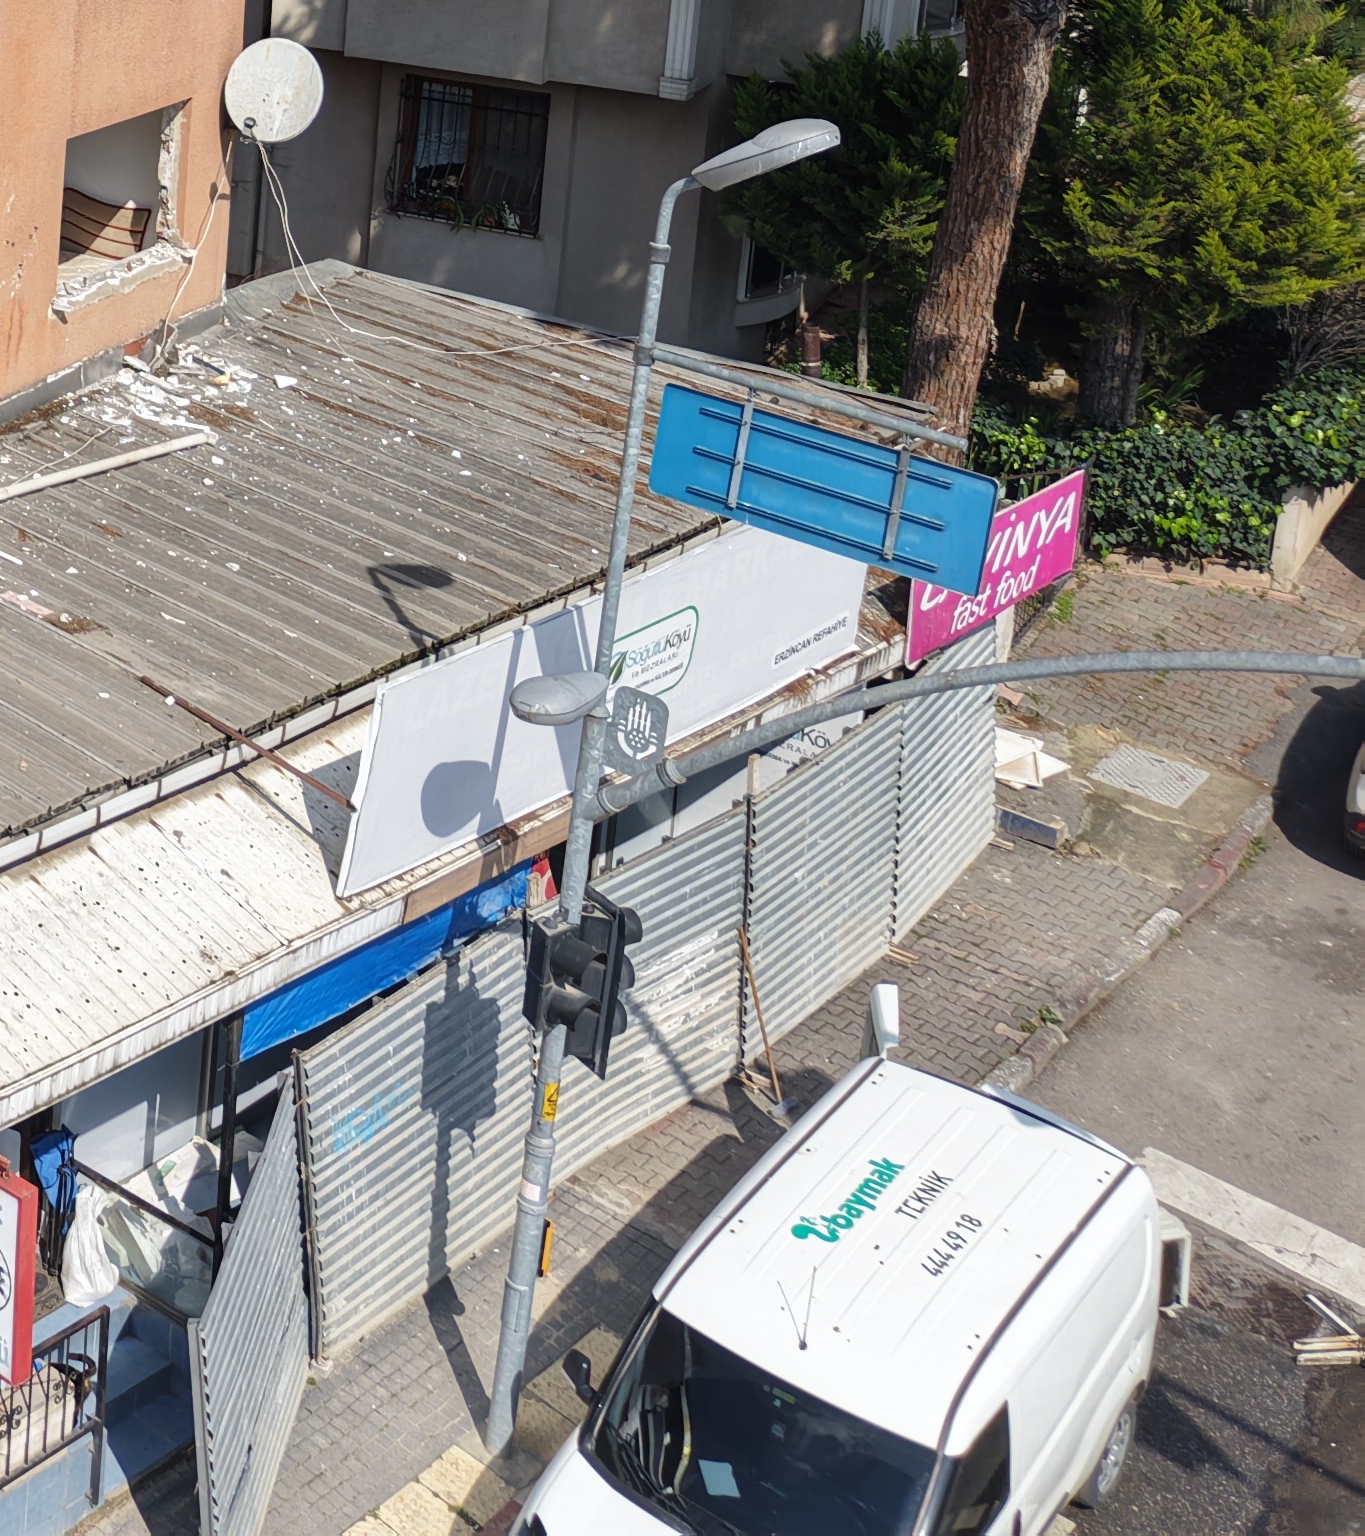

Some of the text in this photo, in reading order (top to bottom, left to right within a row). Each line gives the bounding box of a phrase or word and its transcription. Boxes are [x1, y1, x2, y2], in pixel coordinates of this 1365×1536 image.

[950, 554, 1042, 634] fast food
[815, 1157, 905, 1236] baymak
[920, 1213, 983, 1277] 444 49 18
